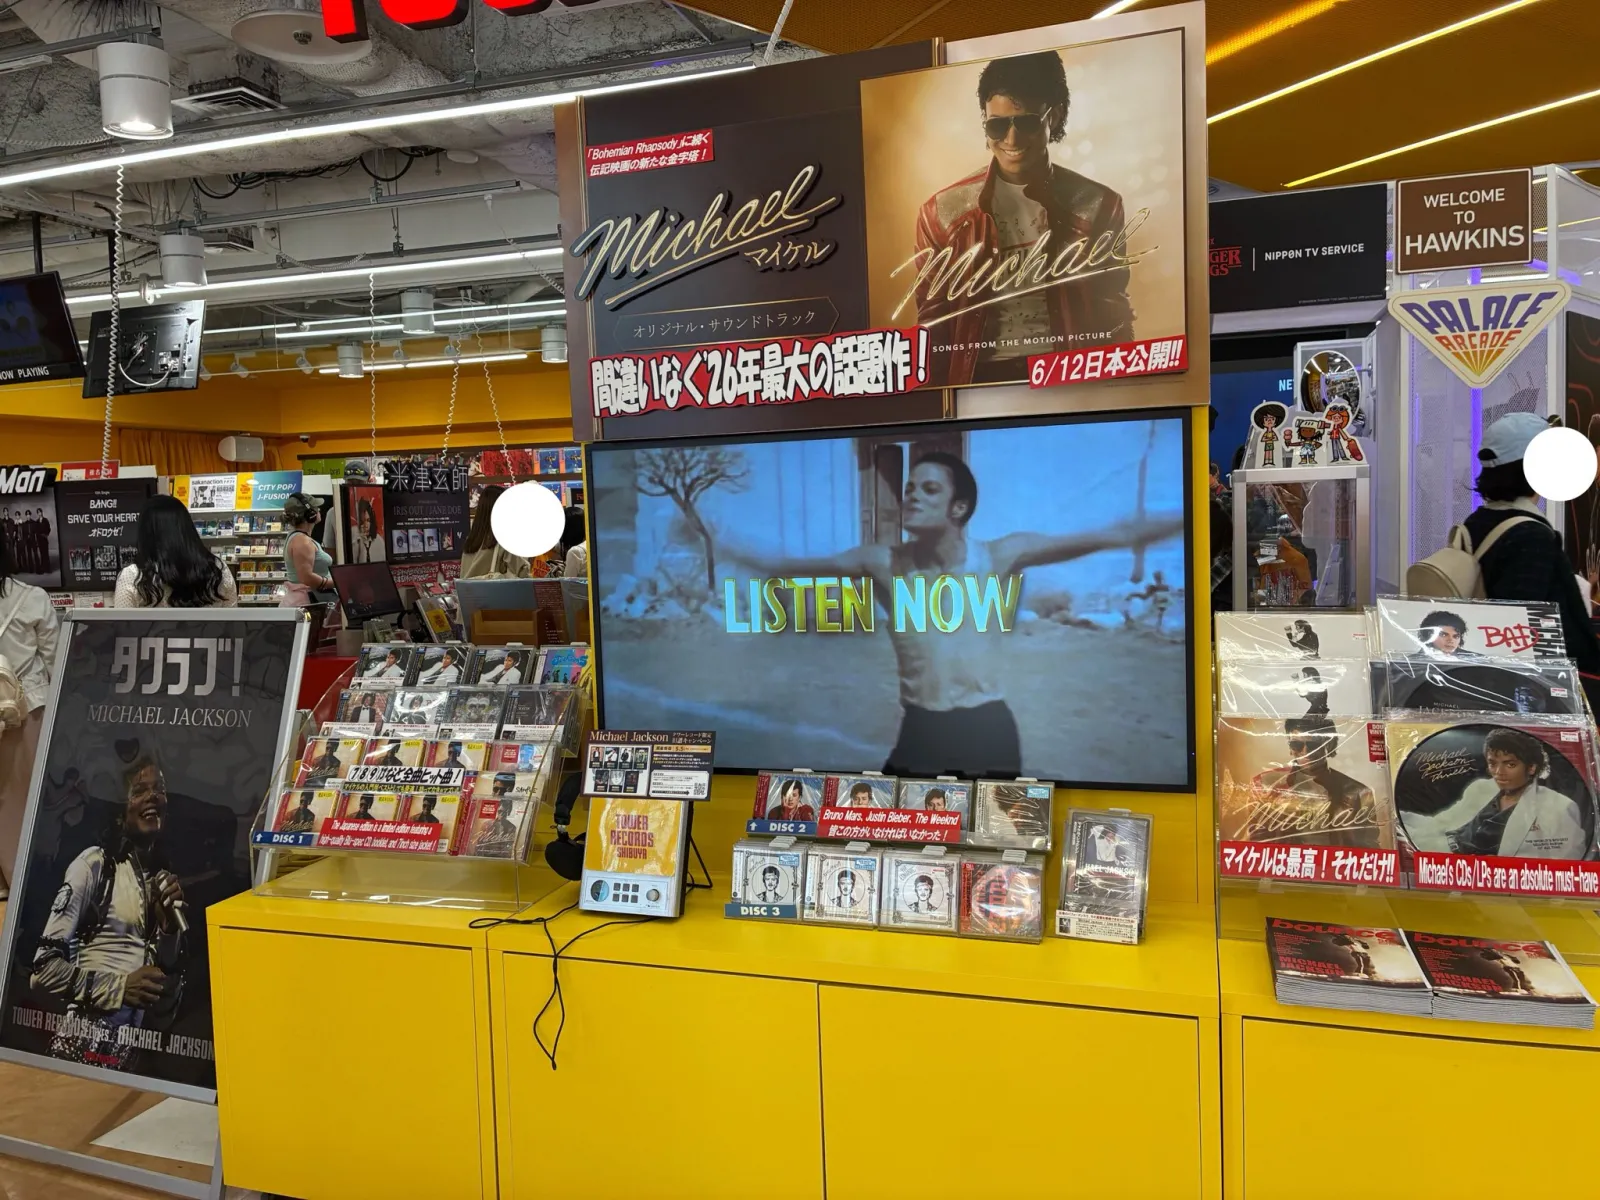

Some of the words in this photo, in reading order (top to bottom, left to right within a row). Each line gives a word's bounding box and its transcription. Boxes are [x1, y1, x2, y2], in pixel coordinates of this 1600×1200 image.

[1424, 188, 1505, 208] WELCOME
[1453, 211, 1475, 224] TO
[574, 165, 837, 297] Michael
[1405, 225, 1524, 255] HAWKINS
[744, 241, 830, 267] マイケル
[1305, 247, 1319, 257] TV
[1322, 243, 1364, 255] SERVICE
[890, 207, 1159, 320] Michael
[1400, 291, 1558, 334] PALACE
[633, 311, 816, 338] オリジナル・サウンドトラック
[932, 344, 965, 352] SONGS
[968, 341, 996, 349] FROM
[1001, 338, 1019, 347] THE
[1023, 335, 1064, 345] MOTION
[1068, 332, 1112, 341] PICTURE
[1435, 330, 1522, 351] ARCADE
[0, 370, 14, 380] OW
[18, 366, 49, 378] PLAYING
[1279, 379, 1294, 391] NE
[391, 463, 468, 491] 米津玄師
[68, 514, 90, 523] SAVE
[92, 513, 113, 523] YOUR
[409, 506, 423, 515] OUT
[448, 505, 461, 514] DOE
[724, 575, 875, 633] LISTEN
[893, 574, 1023, 633] NOW
[1477, 623, 1539, 652] BAD
[87, 705, 165, 725] MICHAEL
[170, 709, 251, 728] JACKSON
[590, 731, 628, 742] Michael
[630, 732, 669, 742] Jackson
[1416, 747, 1471, 765] Michael
[331, 820, 340, 830] The
[616, 813, 648, 830] TOWER
[823, 809, 843, 820] Bruno
[866, 811, 886, 823] Justin
[915, 813, 928, 824] The
[930, 814, 959, 825] Weeknd
[1232, 800, 1396, 838] Michael
[769, 823, 794, 832] DISC
[798, 823, 806, 832] 2
[272, 834, 294, 843] DISC
[610, 830, 654, 847] RECORDS
[616, 847, 647, 859] SHIBUYA
[1419, 857, 1454, 886] Michael's
[1456, 858, 1491, 889] CDs/LPs
[1493, 869, 1507, 889] are
[1509, 870, 1519, 890] an
[1520, 863, 1553, 891] absolute
[1555, 865, 1599, 893] must-have
[740, 906, 769, 916] DISC
[773, 907, 781, 916] 3
[1272, 918, 1397, 940] bounce
[1414, 933, 1545, 952] bounce
[1279, 956, 1341, 969] MICHAEL
[1280, 962, 1345, 976] JACKSON
[1431, 972, 1497, 984] MICHAEL
[1434, 978, 1503, 992] JACKSON
[13, 1006, 43, 1029] TOWER
[118, 1024, 163, 1052] MICHAEL
[166, 1034, 215, 1061] JACKSON
